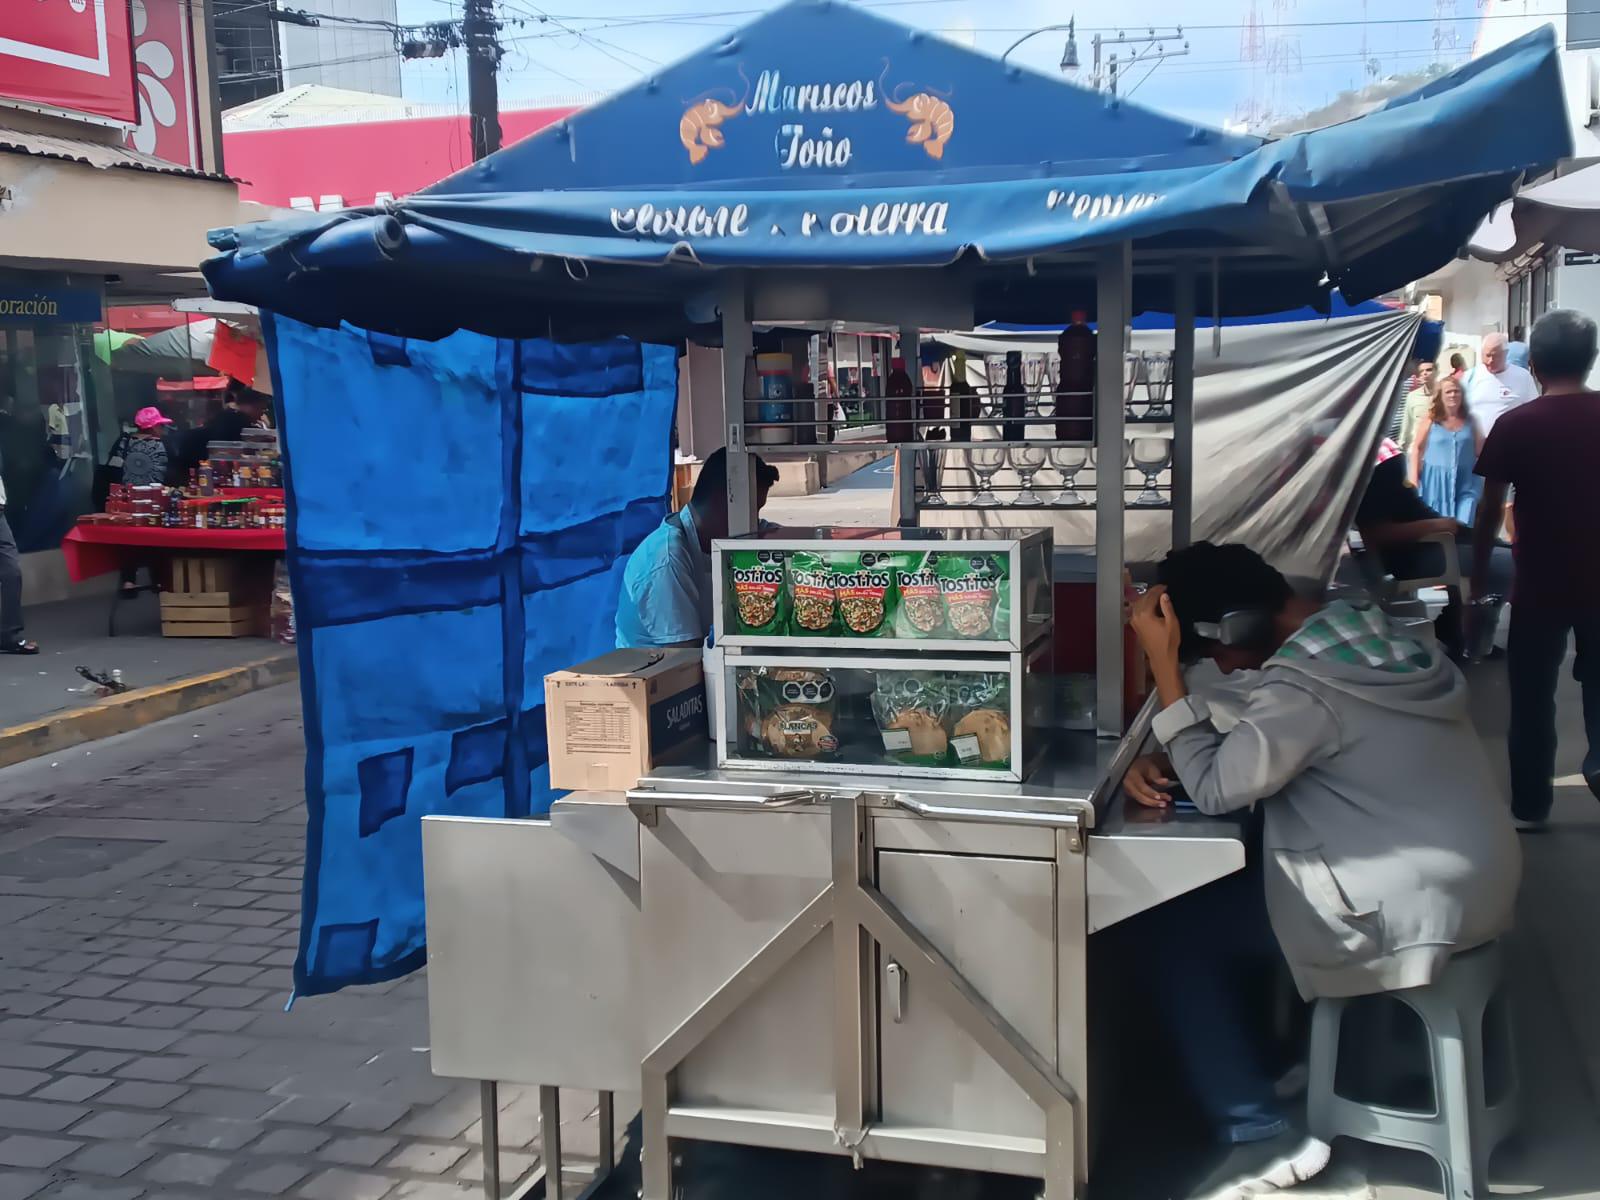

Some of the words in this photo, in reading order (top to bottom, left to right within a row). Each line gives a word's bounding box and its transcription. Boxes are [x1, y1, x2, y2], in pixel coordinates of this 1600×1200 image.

[745, 69, 878, 116] Mariscos
[774, 122, 853, 169] Toño
[0, 295, 58, 316] oración
[666, 694, 703, 729] SALADITAS
